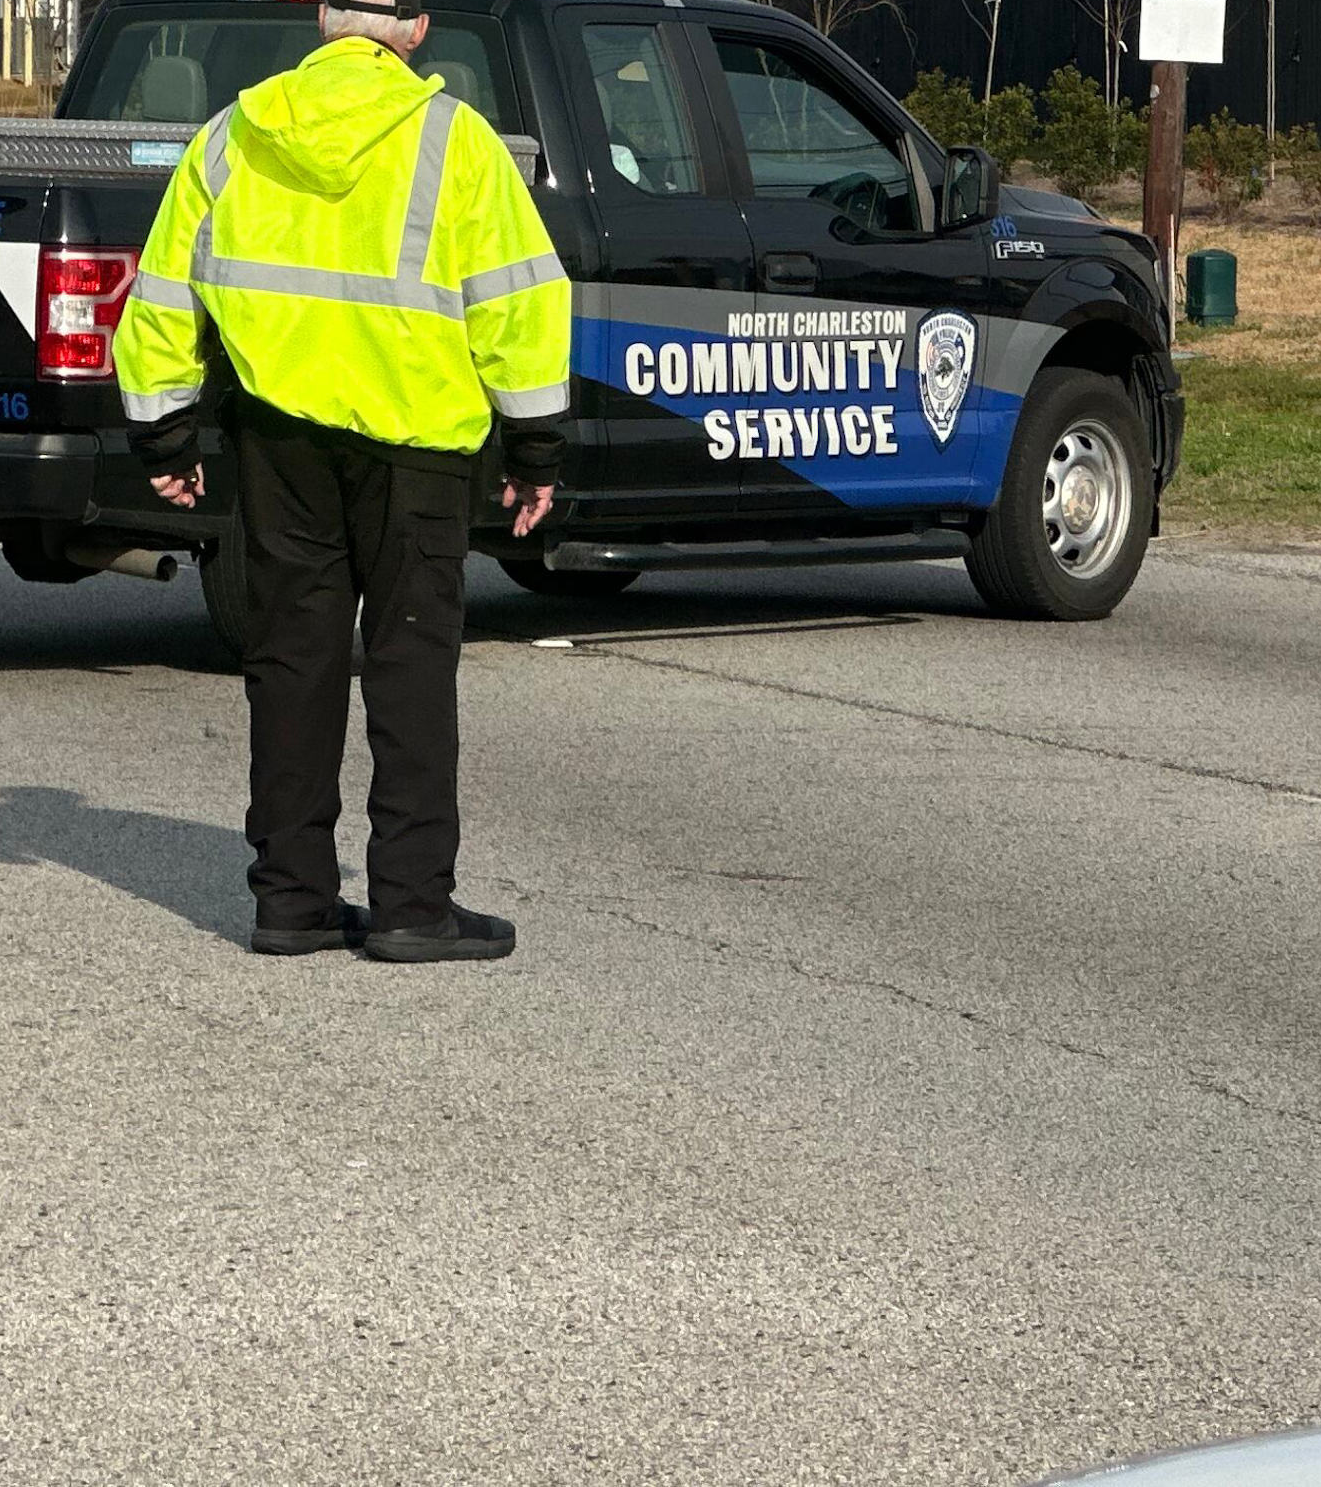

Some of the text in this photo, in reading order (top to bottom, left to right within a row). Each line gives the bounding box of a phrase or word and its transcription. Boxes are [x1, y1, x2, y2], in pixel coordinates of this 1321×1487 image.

[990, 215, 1016, 237] 316
[728, 311, 906, 338] NORTH CHARLESTON
[624, 338, 905, 396] COMMUNITY
[705, 405, 899, 462] SERVICE
